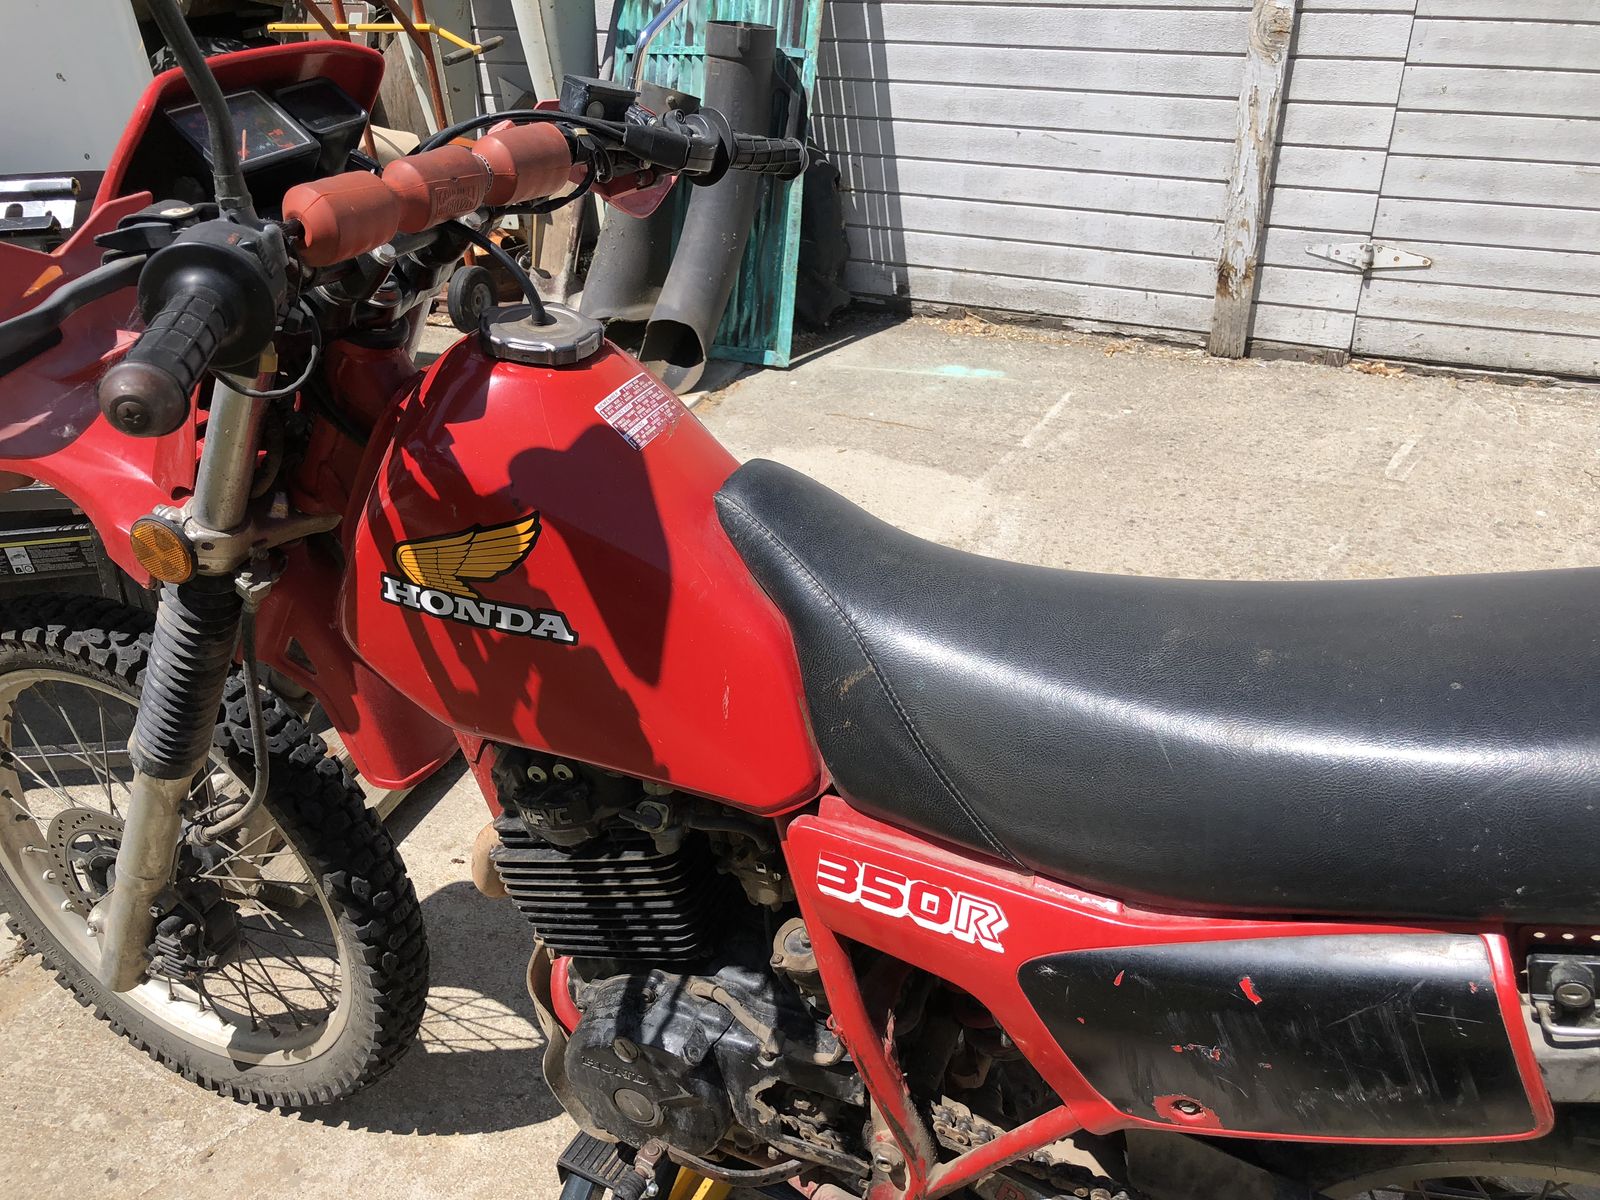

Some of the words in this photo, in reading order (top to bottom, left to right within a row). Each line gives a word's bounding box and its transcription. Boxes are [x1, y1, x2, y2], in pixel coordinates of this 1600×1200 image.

[383, 576, 575, 642] HONDA
[816, 850, 1009, 953] 350R
[581, 1055, 662, 1090] HOND
